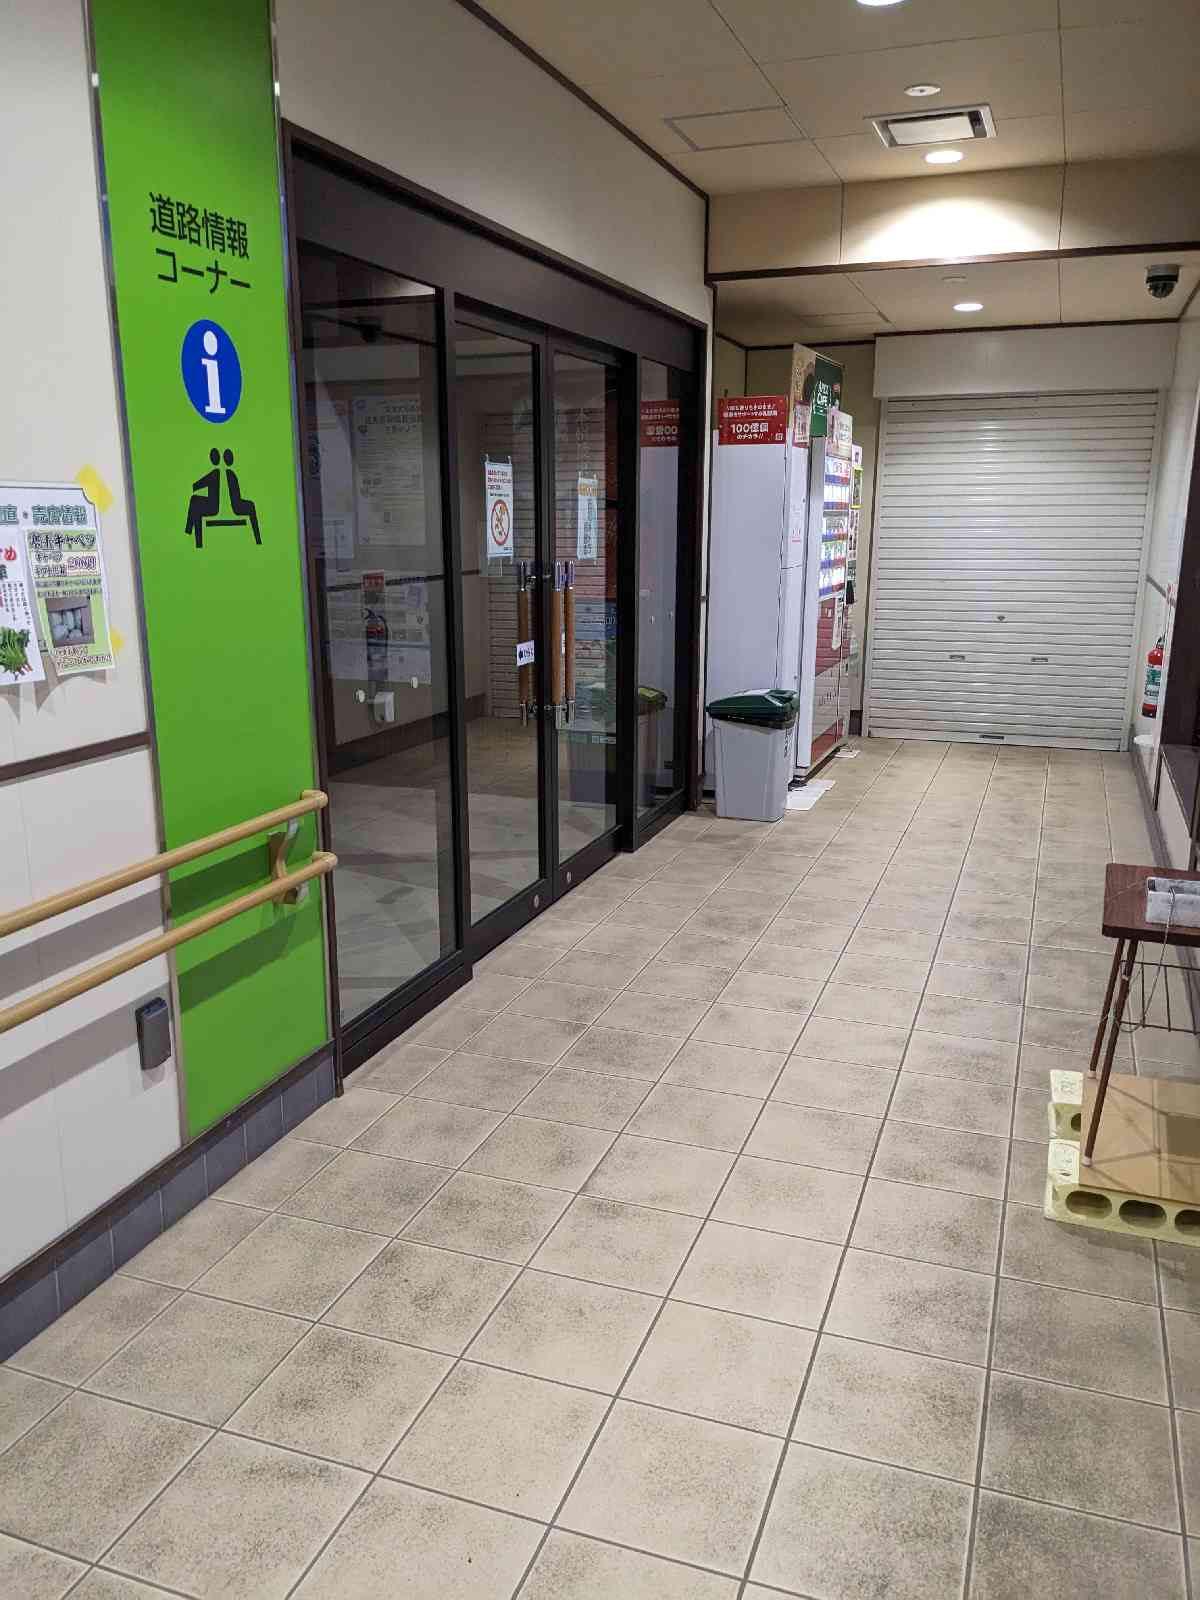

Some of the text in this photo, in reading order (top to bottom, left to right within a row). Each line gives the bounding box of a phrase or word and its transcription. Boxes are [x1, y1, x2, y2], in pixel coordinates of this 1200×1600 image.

[149, 191, 250, 260] 道路情報
[155, 247, 252, 294] コーナー
[730, 422, 769, 434] 100億個
